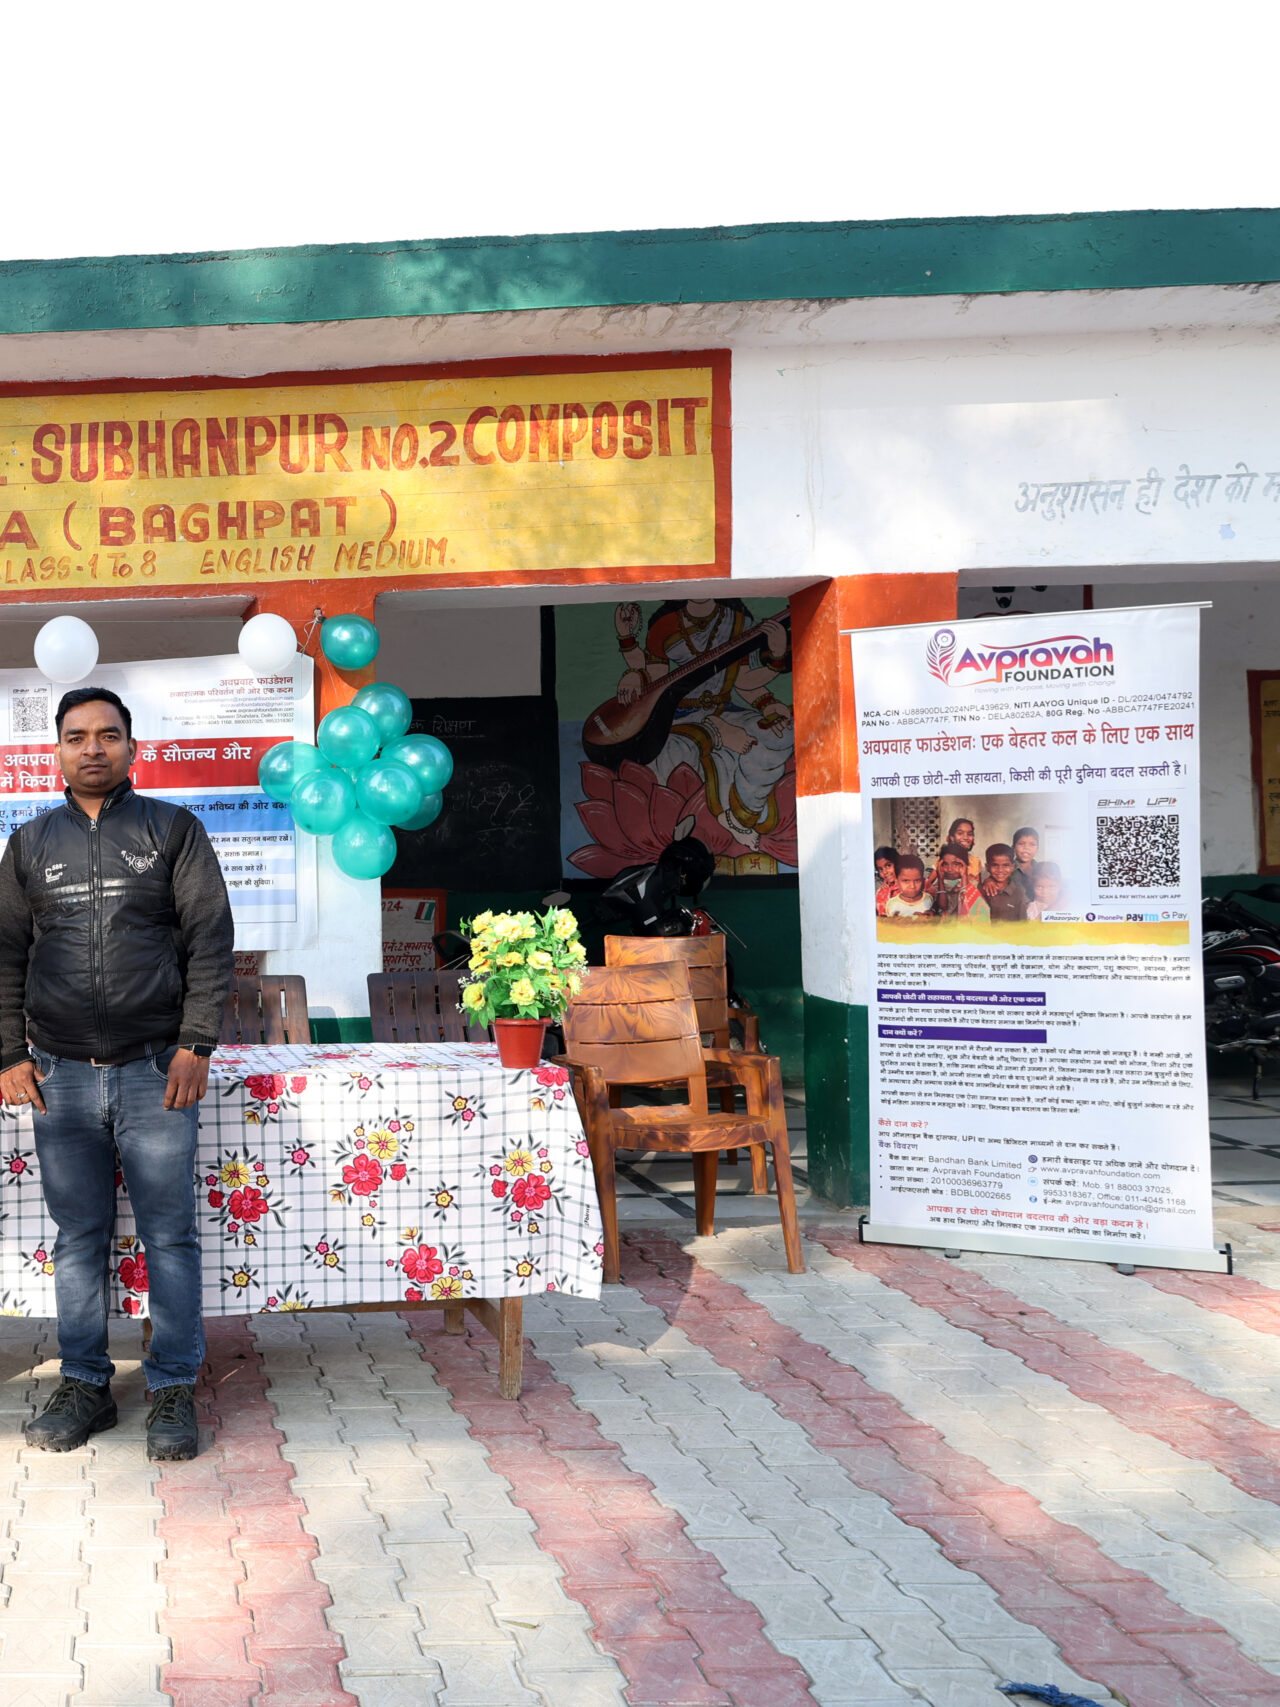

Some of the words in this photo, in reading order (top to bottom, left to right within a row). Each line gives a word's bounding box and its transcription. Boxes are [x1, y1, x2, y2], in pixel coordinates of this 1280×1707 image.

[32, 414, 353, 483] SUBHANPUR
[361, 420, 460, 471] NO.2
[463, 397, 708, 465] COMPOSIT
[1015, 479, 1131, 521] अनुशासन
[1136, 467, 1165, 515] ही
[1174, 464, 1222, 510] देश
[1224, 462, 1258, 503] को
[142, 550, 157, 576] 8
[200, 544, 315, 575] ENGLISH
[334, 536, 456, 572] MEDIUM.
[954, 637, 1114, 683] Avpravah
[1004, 665, 1115, 683] FOUNDATION
[1014, 700, 1031, 709] NITI
[1033, 700, 1065, 708] AAYOG
[1068, 699, 1098, 707] Unique
[1046, 709, 1063, 717] 80G
[1088, 707, 1100, 715] No
[862, 734, 912, 756] अवप्रवाह
[981, 734, 1004, 752] एक
[1009, 727, 1046, 749] बेहतर
[1051, 729, 1078, 748] कल
[1082, 722, 1096, 744] के
[1100, 721, 1129, 744] लिए
[1135, 728, 1160, 744] एक
[1165, 723, 1195, 741] साथ
[4, 753, 58, 767] अवप्रवा
[142, 745, 158, 762] के
[162, 743, 216, 762] सौजन्य
[222, 741, 252, 760] और
[0, 772, 14, 788] में
[19, 772, 57, 788] किया
[871, 772, 901, 788] आपकी
[904, 774, 920, 788] एक
[923, 771, 962, 786] छोटी-सी
[965, 770, 1005, 784] सहायता,
[1009, 767, 1035, 783] किसी
[1039, 767, 1051, 782] की
[1055, 765, 1073, 785] पूरी
[1075, 764, 1107, 784] दुनिया
[1110, 766, 1135, 779] बदल
[1138, 762, 1171, 777] सकती
[11, 806, 33, 818] हमारे
[208, 801, 235, 811] भविष्य
[239, 801, 249, 810] की
[252, 800, 269, 809] ओर
[1097, 798, 1131, 808] BHIM
[245, 878, 252, 886] की
[1172, 912, 1188, 920] Pay
[928, 1156, 966, 1164] Bandhan
[968, 1158, 989, 1166] Bank
[991, 1160, 1022, 1169] Limited
[932, 1167, 971, 1176] Avpravah
[974, 1169, 1021, 1180] Foundation
[926, 1204, 954, 1214] आपका
[991, 1208, 1023, 1220] योगदान
[1058, 1212, 1070, 1223] की
[1073, 1215, 1090, 1225] ओर
[1111, 1219, 1134, 1228] कदम
